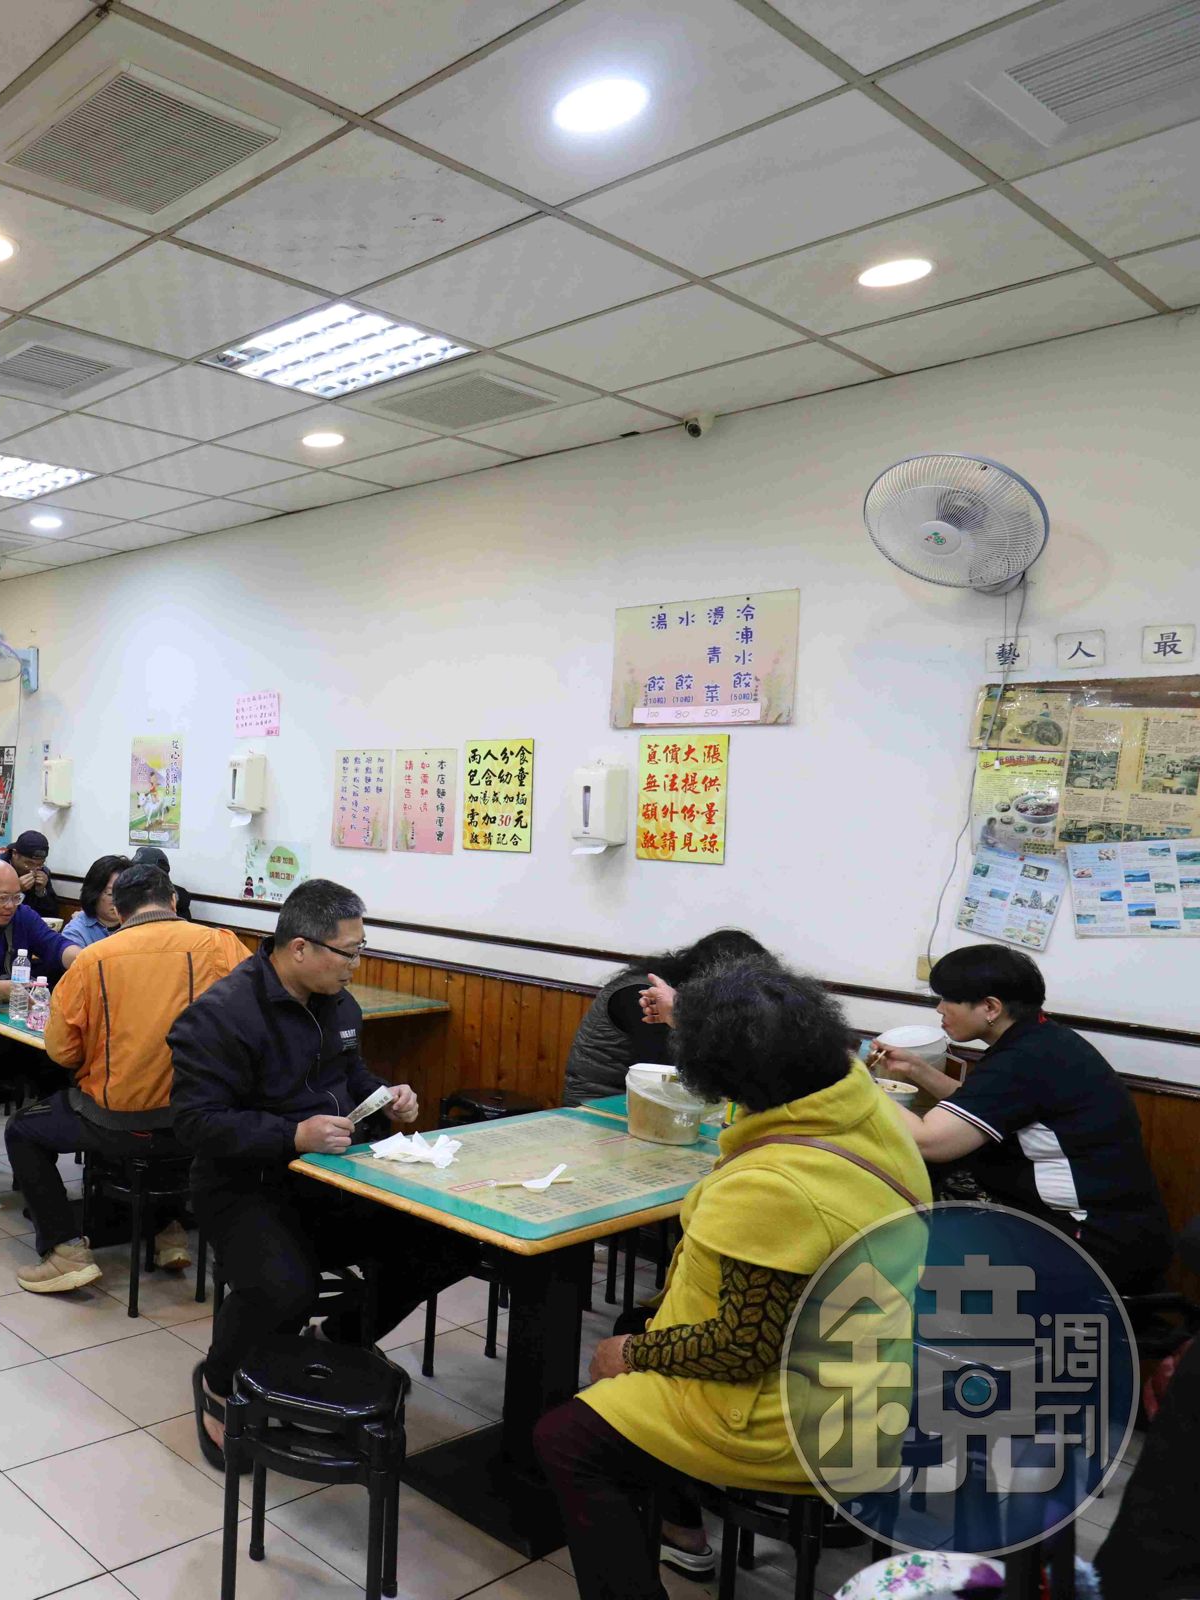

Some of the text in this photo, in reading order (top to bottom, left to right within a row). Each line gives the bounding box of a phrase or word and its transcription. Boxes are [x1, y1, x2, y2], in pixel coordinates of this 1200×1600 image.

[704, 606, 725, 703] 燙青菜
[734, 604, 756, 689] 冷凍水餃
[468, 746, 532, 765] 兩人分食
[467, 766, 530, 787] 包含幼童
[642, 772, 722, 794] 無法提供
[468, 790, 527, 806] 加湯或加麵
[466, 808, 529, 829] 需加30元
[641, 802, 719, 825] 額外份量
[469, 832, 522, 846] 敬請配合
[641, 830, 720, 853] 敬請見諒
